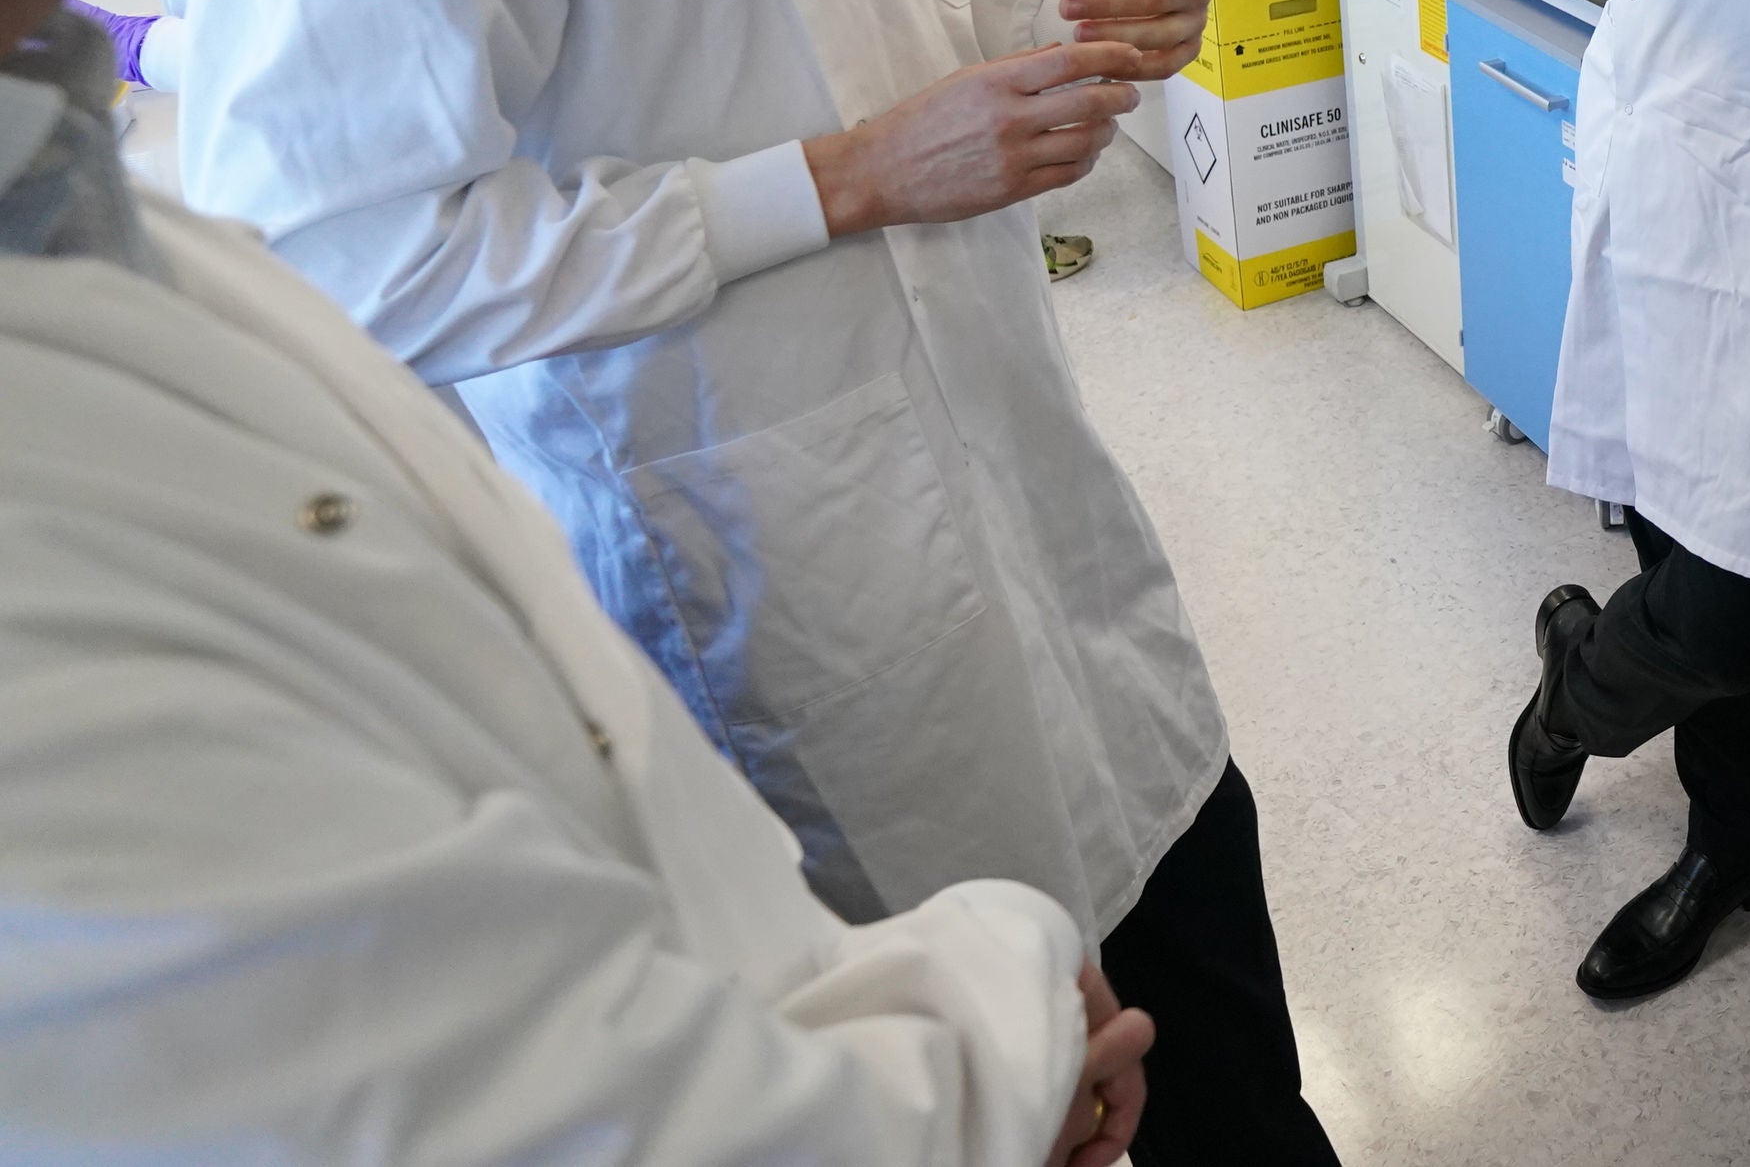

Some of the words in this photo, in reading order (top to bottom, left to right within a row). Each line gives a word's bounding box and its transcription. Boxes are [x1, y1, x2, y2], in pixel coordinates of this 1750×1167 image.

[1260, 111, 1324, 139] CLINISAFE
[1326, 107, 1342, 123] 50
[1256, 215, 1271, 226] AND
[1273, 211, 1289, 221] NON
[1291, 200, 1328, 217] PACKAGED
[1257, 203, 1272, 213] NOT
[1274, 193, 1309, 209] SUITABLE
[1310, 189, 1325, 200] FOR
